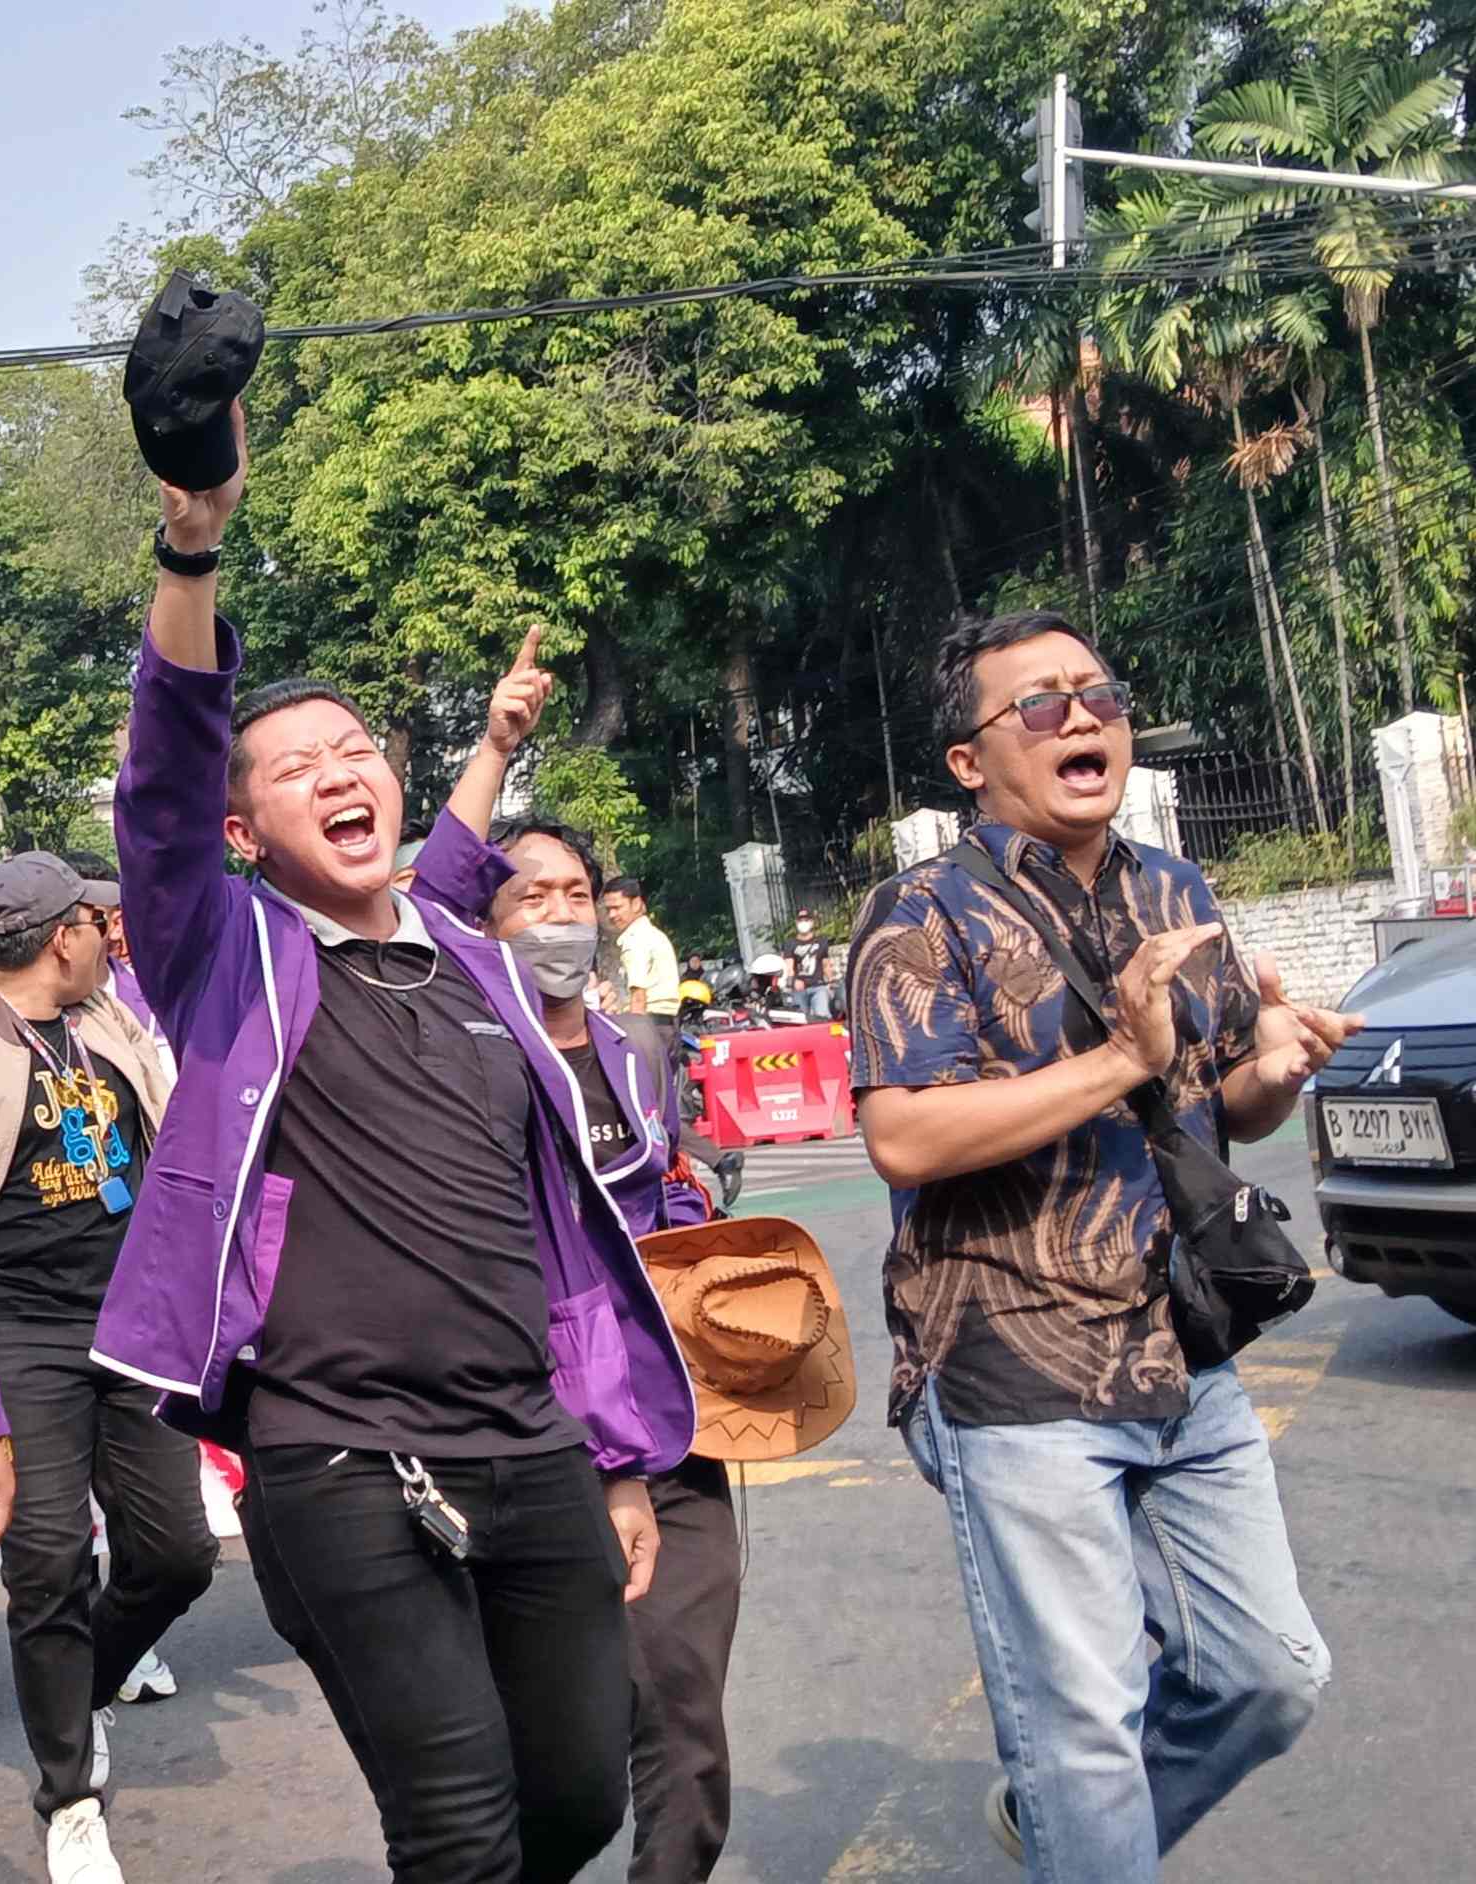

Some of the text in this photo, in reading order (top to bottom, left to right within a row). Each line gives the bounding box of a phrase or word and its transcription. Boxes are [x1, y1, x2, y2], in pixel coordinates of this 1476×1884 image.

[1328, 1109, 1435, 1140] B 2297 BYH
